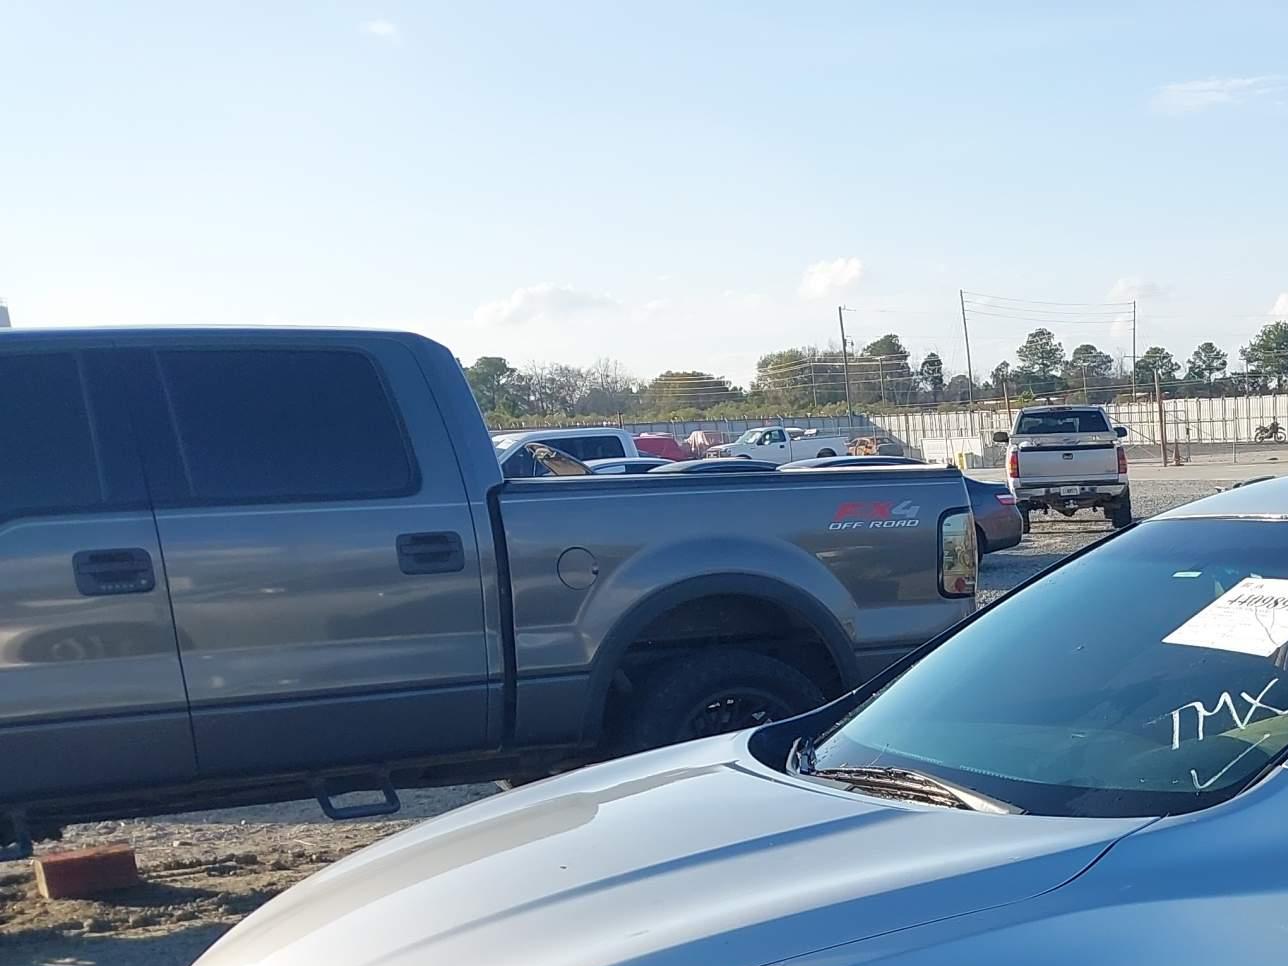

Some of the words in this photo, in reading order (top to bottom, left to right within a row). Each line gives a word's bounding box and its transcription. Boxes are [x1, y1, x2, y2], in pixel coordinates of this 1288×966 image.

[833, 500, 921, 520] FX4
[828, 521, 865, 531] OFF
[868, 519, 920, 529] ROAD
